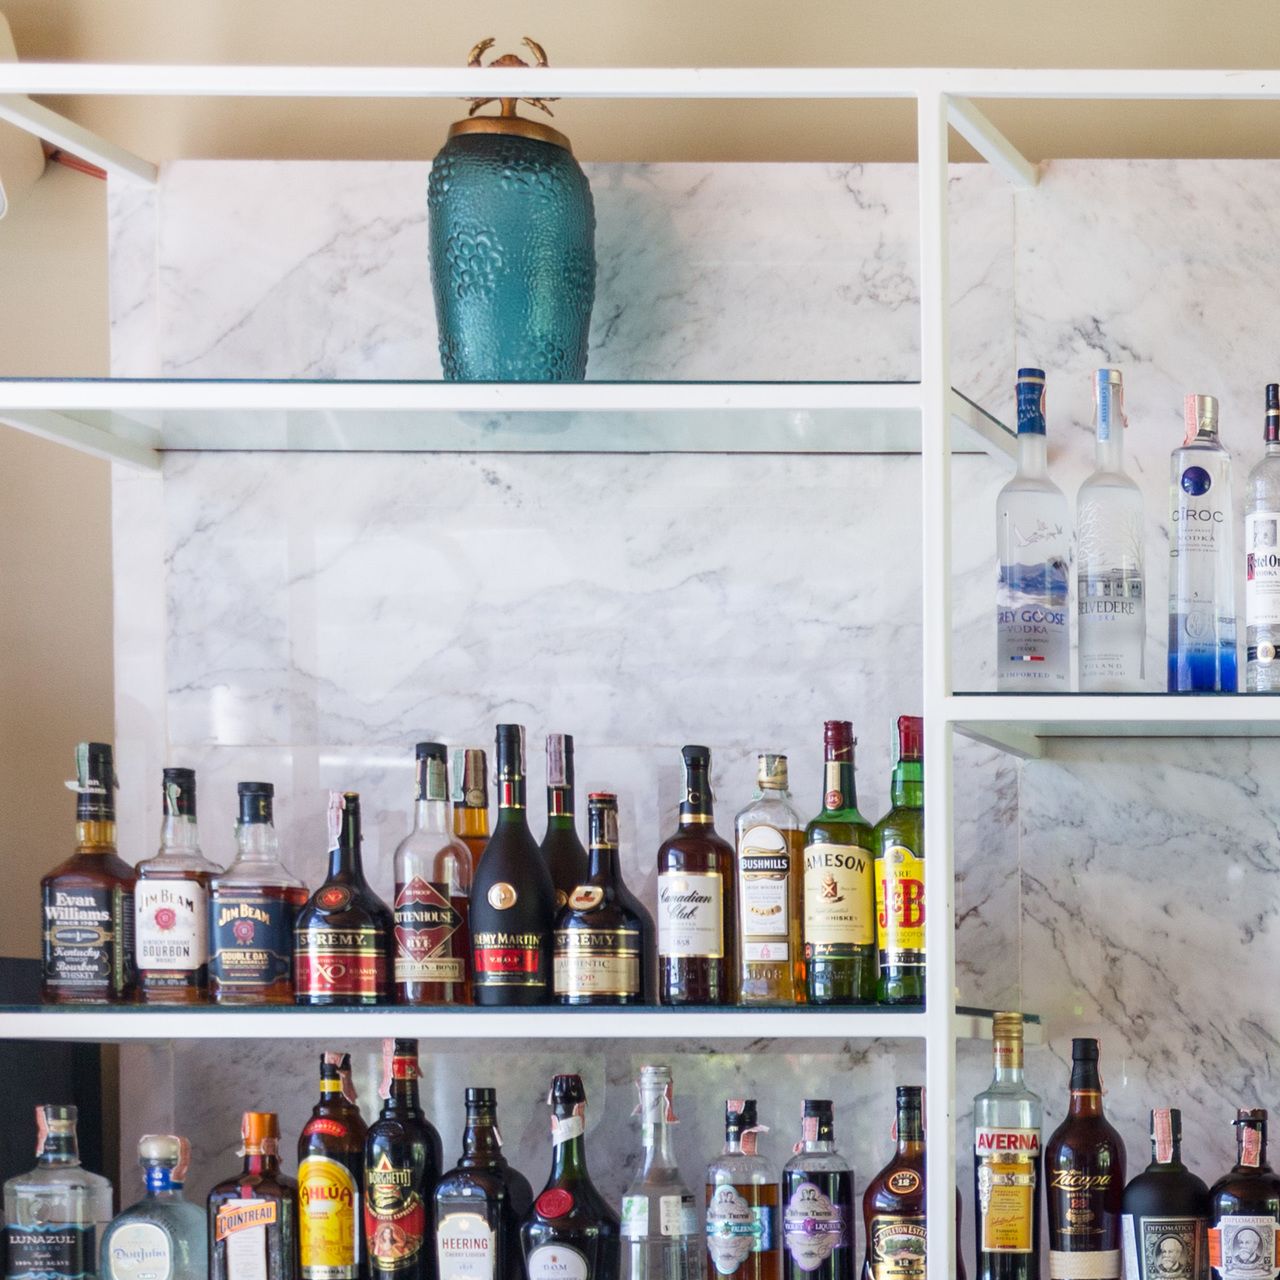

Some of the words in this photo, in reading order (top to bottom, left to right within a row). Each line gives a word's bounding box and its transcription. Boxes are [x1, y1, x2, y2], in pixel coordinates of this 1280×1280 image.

[1021, 610, 1065, 625] GOOSE
[1007, 624, 1048, 634] VODKA
[742, 858, 787, 869] BUSHMILLS
[56, 892, 96, 906] Evan
[139, 893, 158, 913] JIM
[161, 889, 194, 913] BEAM
[660, 887, 713, 904] Canadian
[219, 907, 239, 926] JIM
[240, 904, 270, 926] BEAM
[407, 938, 431, 949] RYE
[498, 932, 541, 945] MARTIN
[54, 948, 100, 959] Kentucky
[143, 945, 190, 957] BOURBON
[222, 952, 249, 961] DOUBLE
[251, 952, 268, 961] OAK
[56, 961, 99, 972] Bourbon
[314, 963, 346, 984] XO
[978, 1134, 1038, 1150] AVERNA
[1051, 1169, 1112, 1190] Zacapa
[219, 1204, 273, 1234] COINTREAU
[10, 1235, 74, 1244] LUNAZUL
[442, 1237, 488, 1249] HEERING
